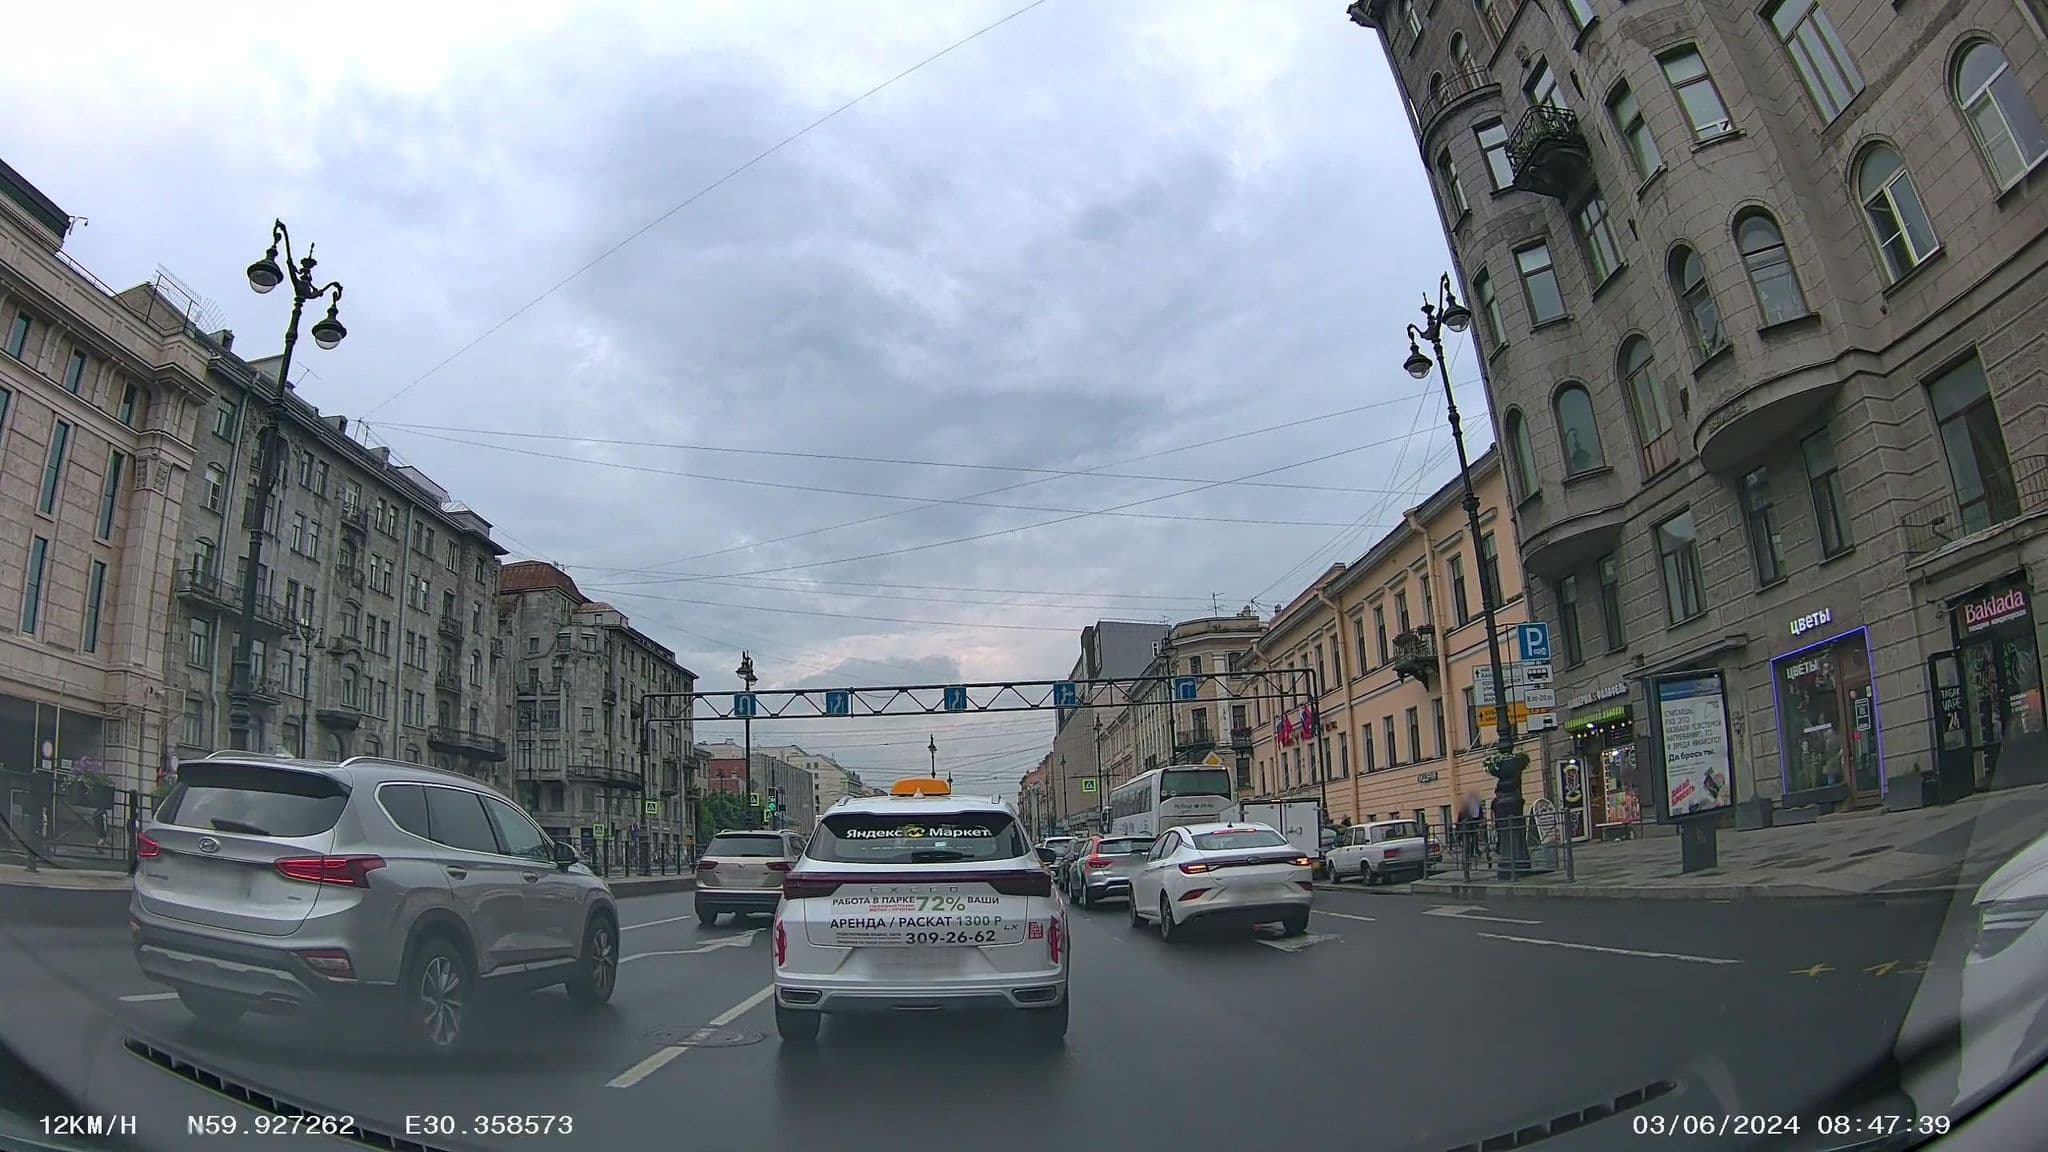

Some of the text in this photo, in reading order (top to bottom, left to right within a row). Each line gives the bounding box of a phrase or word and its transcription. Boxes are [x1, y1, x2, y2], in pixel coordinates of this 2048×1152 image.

[1965, 589, 2026, 624] Baklada
[1786, 659, 1819, 680] ЦВЕТЫ
[1947, 711, 1960, 731] 24
[1668, 753, 1680, 763] Да
[1680, 750, 1703, 761] брось
[846, 827, 992, 839] Яндекс Маркет
[832, 895, 1000, 912] РАБОТА В ПАРКЕ 72% ВАШИ
[830, 917, 886, 930] АРЕНДА
[899, 916, 952, 928] РАСКАТ
[956, 916, 990, 927] 1300
[905, 929, 996, 945] 309-26-62
